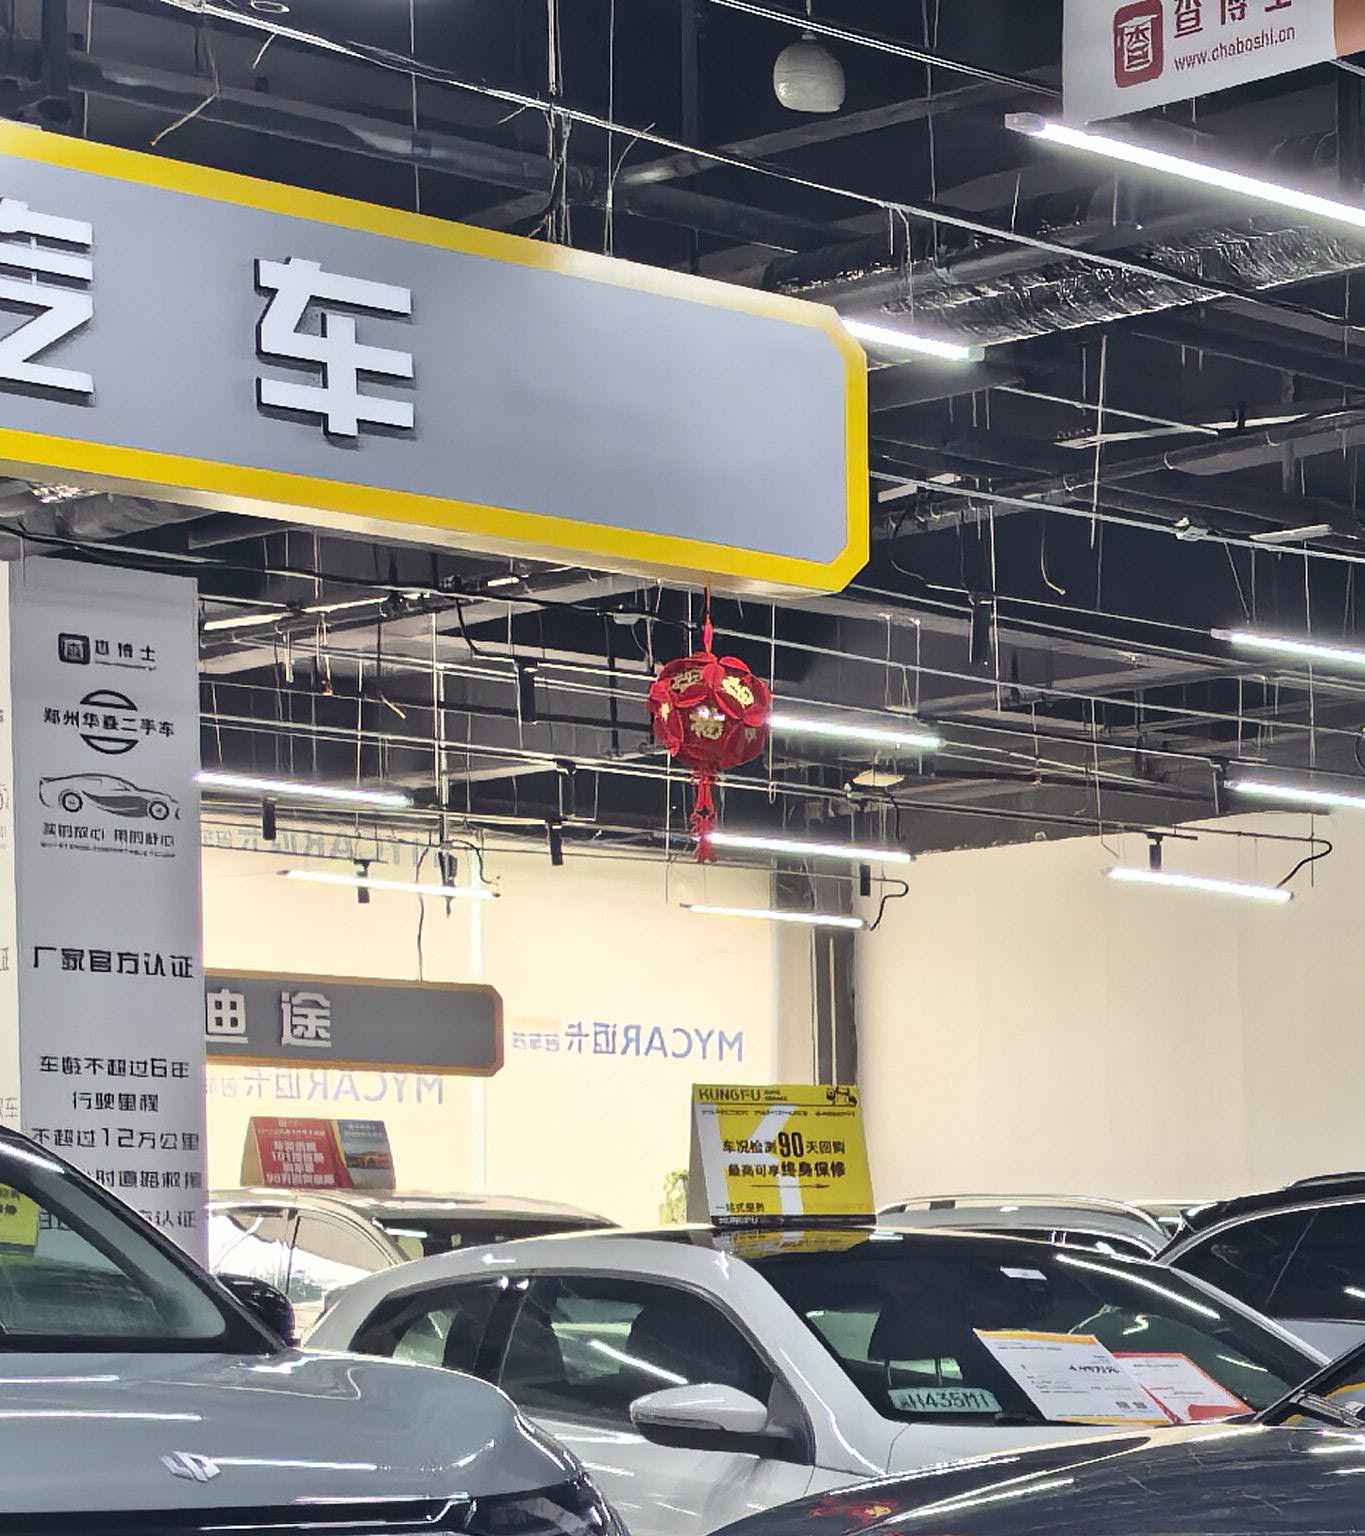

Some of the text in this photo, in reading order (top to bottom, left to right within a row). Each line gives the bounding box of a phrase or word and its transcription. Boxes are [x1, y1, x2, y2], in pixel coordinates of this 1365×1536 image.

[32, 945, 195, 979] 厂家官方认证
[39, 1054, 190, 1080] 车龄不超过6年
[30, 1126, 201, 1151] 不超过12万公里
